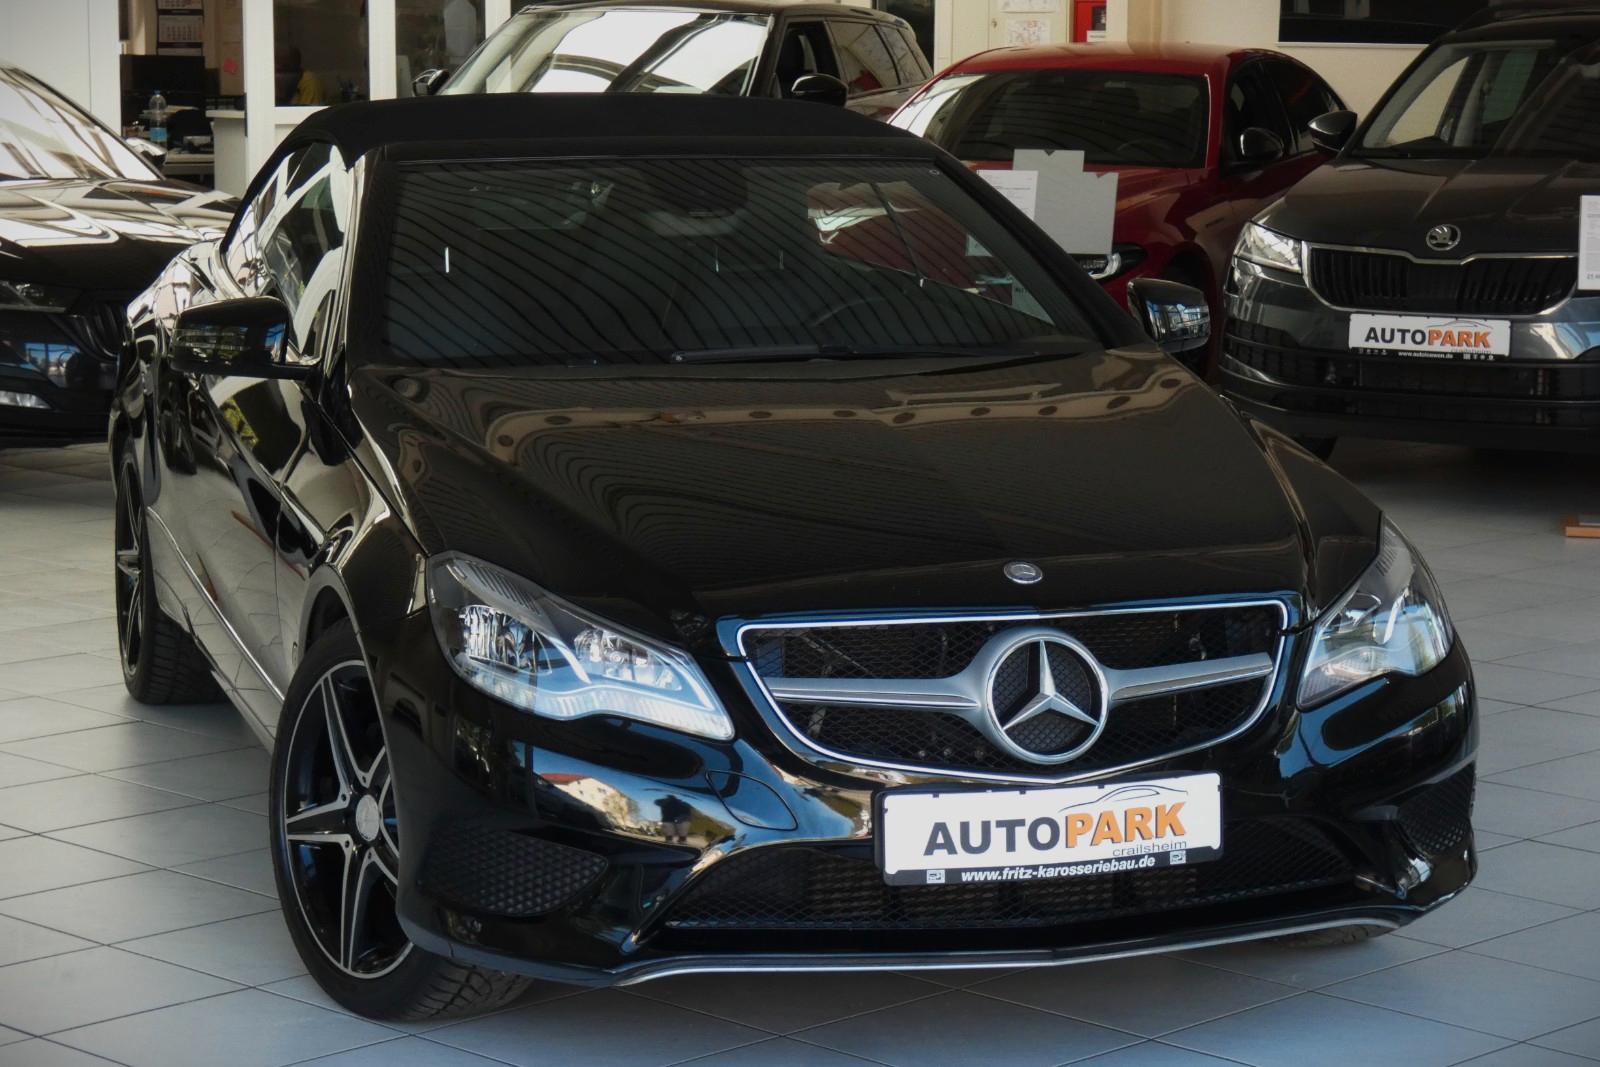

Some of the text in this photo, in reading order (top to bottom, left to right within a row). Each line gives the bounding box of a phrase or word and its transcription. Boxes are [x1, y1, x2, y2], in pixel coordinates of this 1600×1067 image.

[1364, 327, 1491, 348] AUTOPARK
[923, 801, 1187, 857] AUTOPARK
[1112, 839, 1187, 857] crailsheim
[961, 855, 1156, 882] www.fritz-karosseriebau.de
